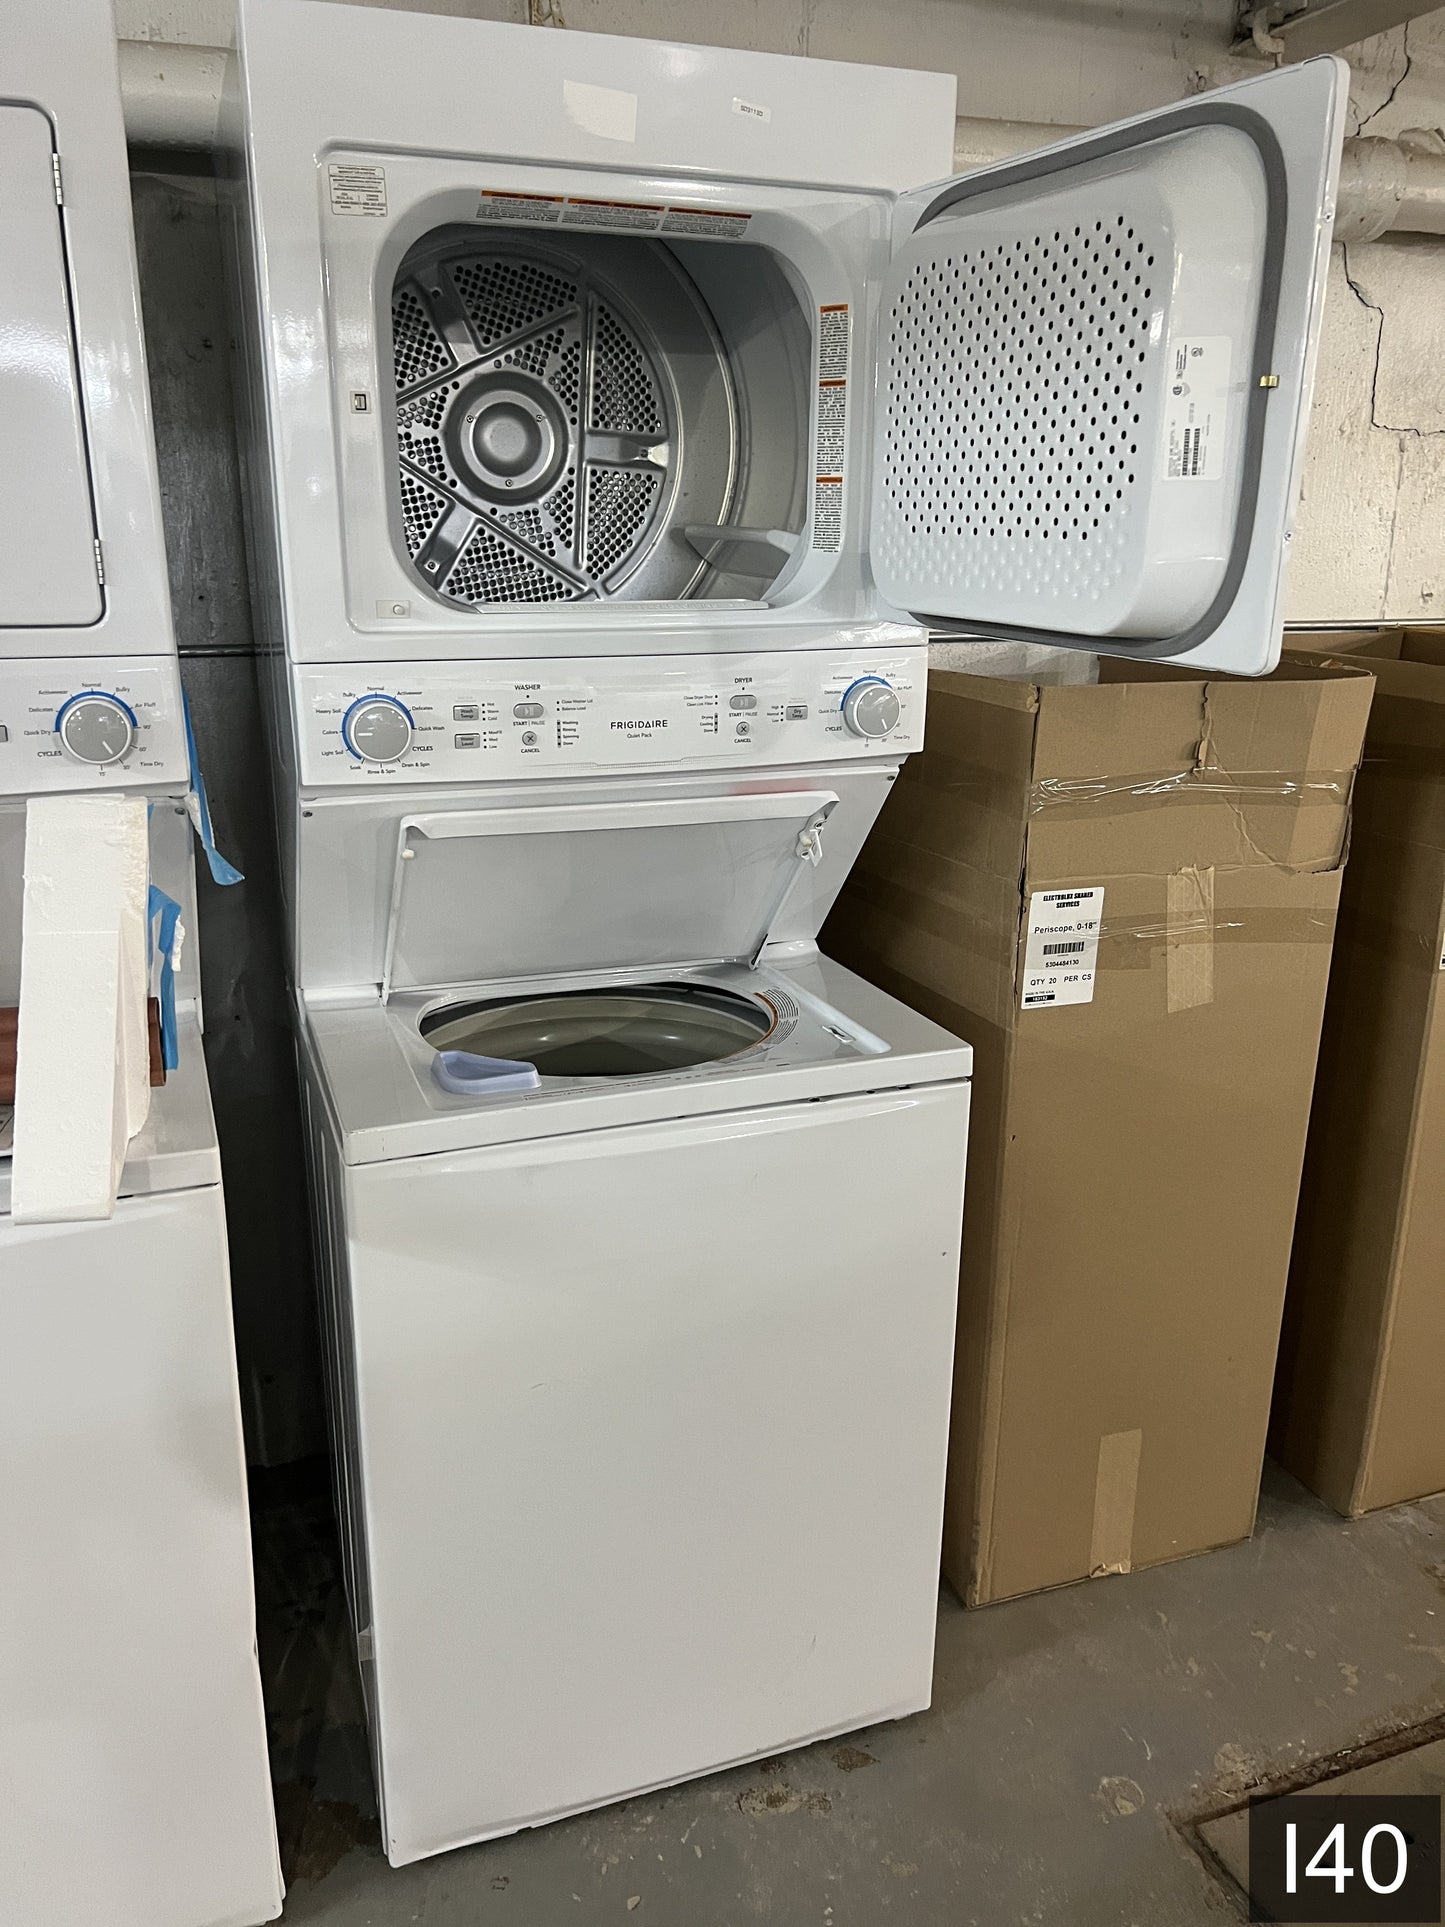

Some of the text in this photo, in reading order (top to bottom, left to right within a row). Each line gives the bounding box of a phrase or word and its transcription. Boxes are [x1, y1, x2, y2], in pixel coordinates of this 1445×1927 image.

[610, 719, 668, 730] FRIGIDAIRE
[37, 750, 62, 758] CYCLES
[1030, 973, 1092, 986] QTY 20 PER CS
